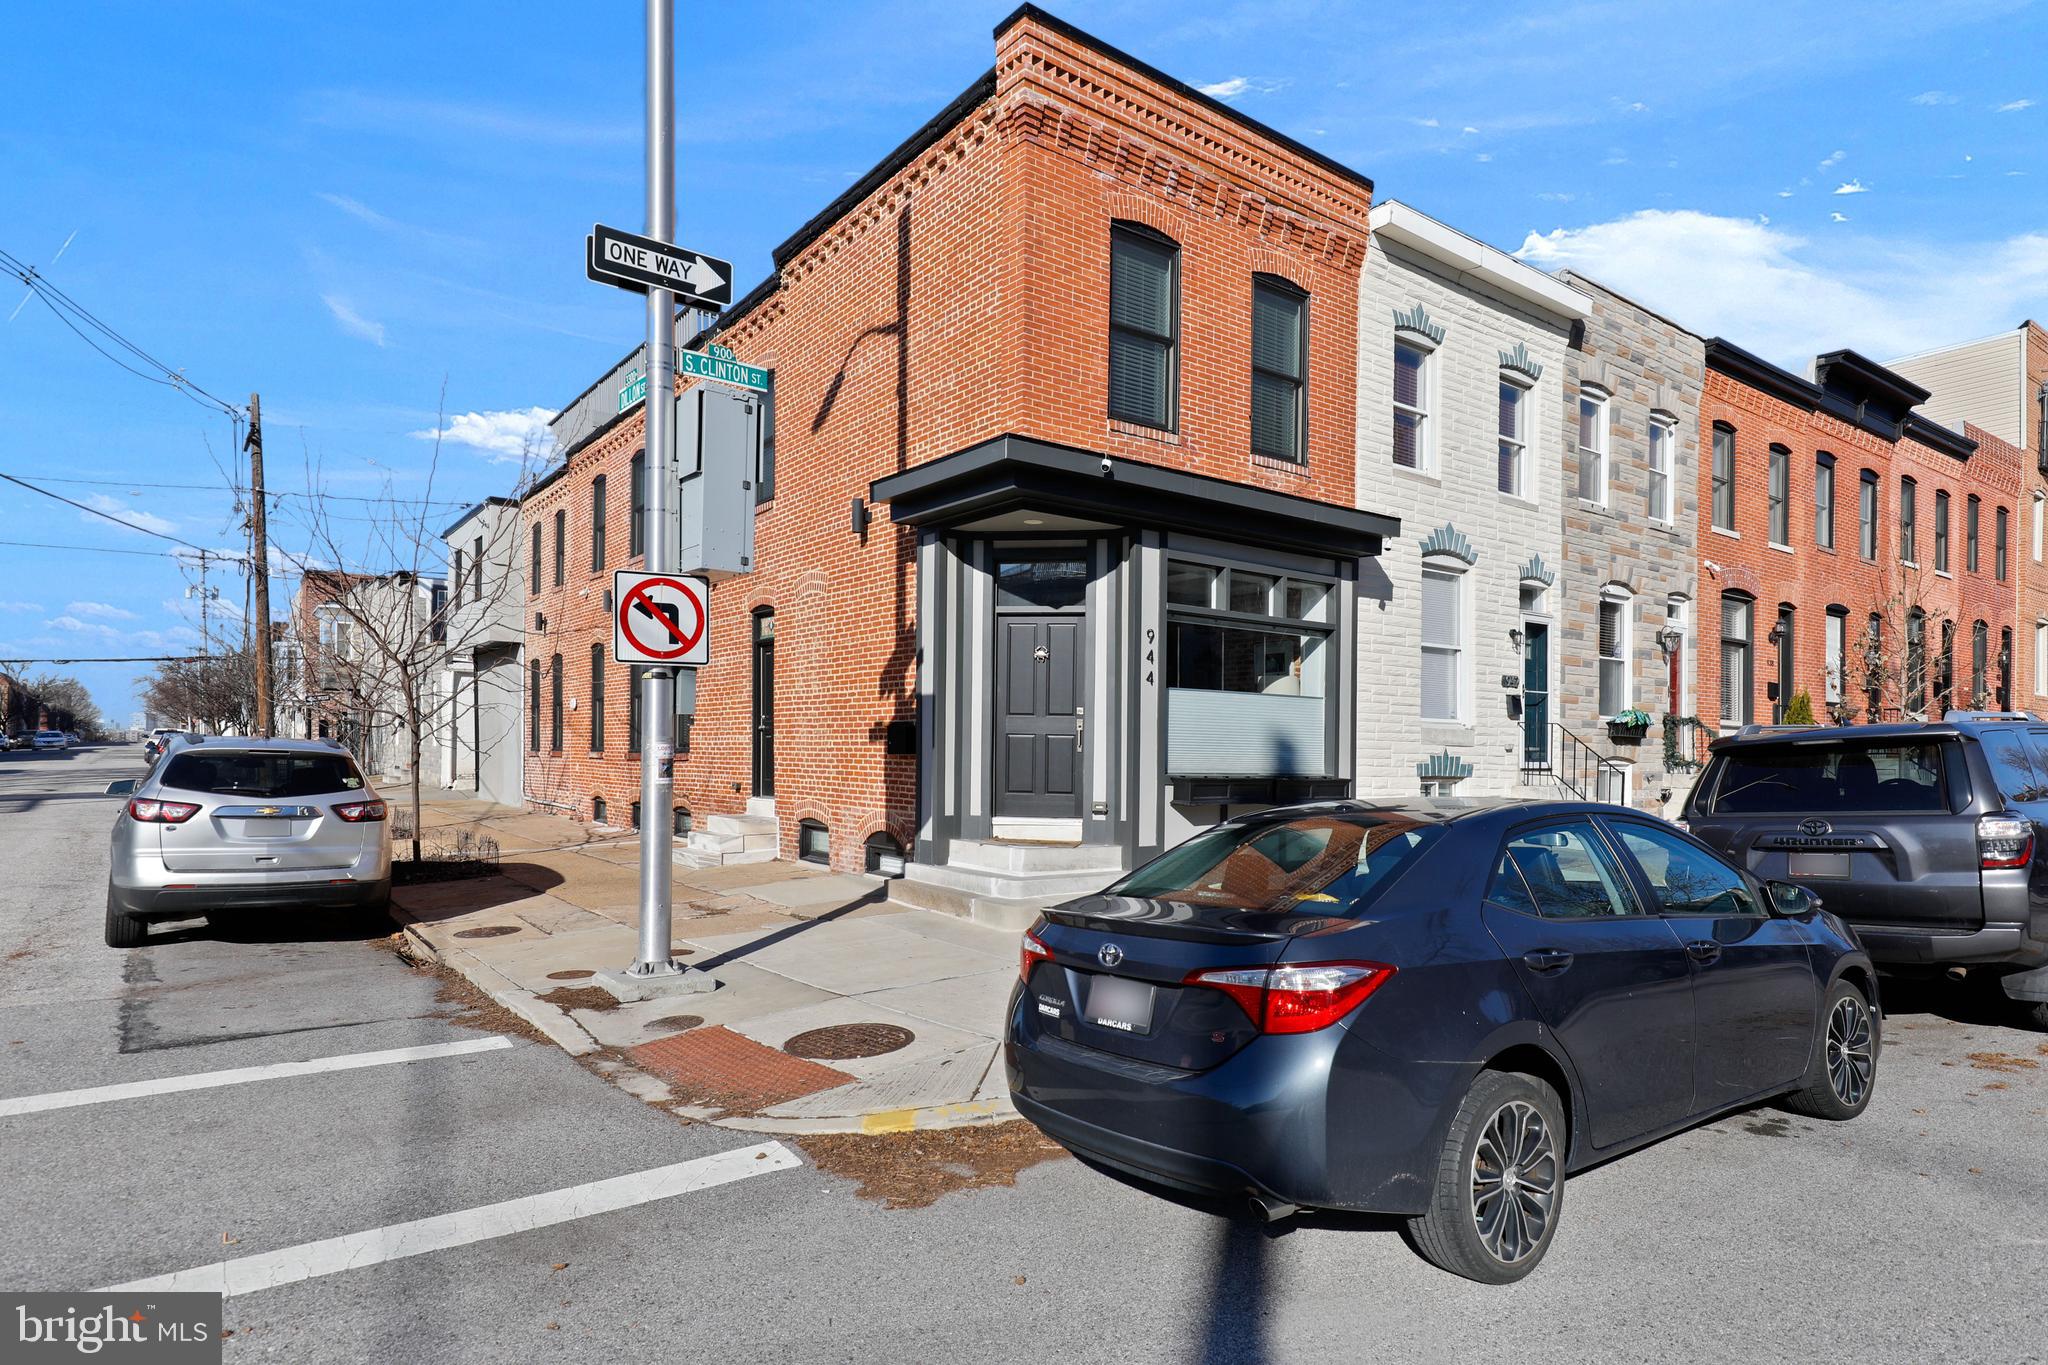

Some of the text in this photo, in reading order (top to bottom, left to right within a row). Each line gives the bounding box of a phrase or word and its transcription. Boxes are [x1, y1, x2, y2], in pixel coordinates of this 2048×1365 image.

[610, 243, 692, 280] ONE WAY
[713, 346, 732, 360] 900
[685, 354, 764, 386] S. CLINTON ST.
[1146, 628, 1155, 687] 944
[1038, 1003, 1060, 1017] DARCARS
[1097, 1017, 1132, 1032] DARCARS
